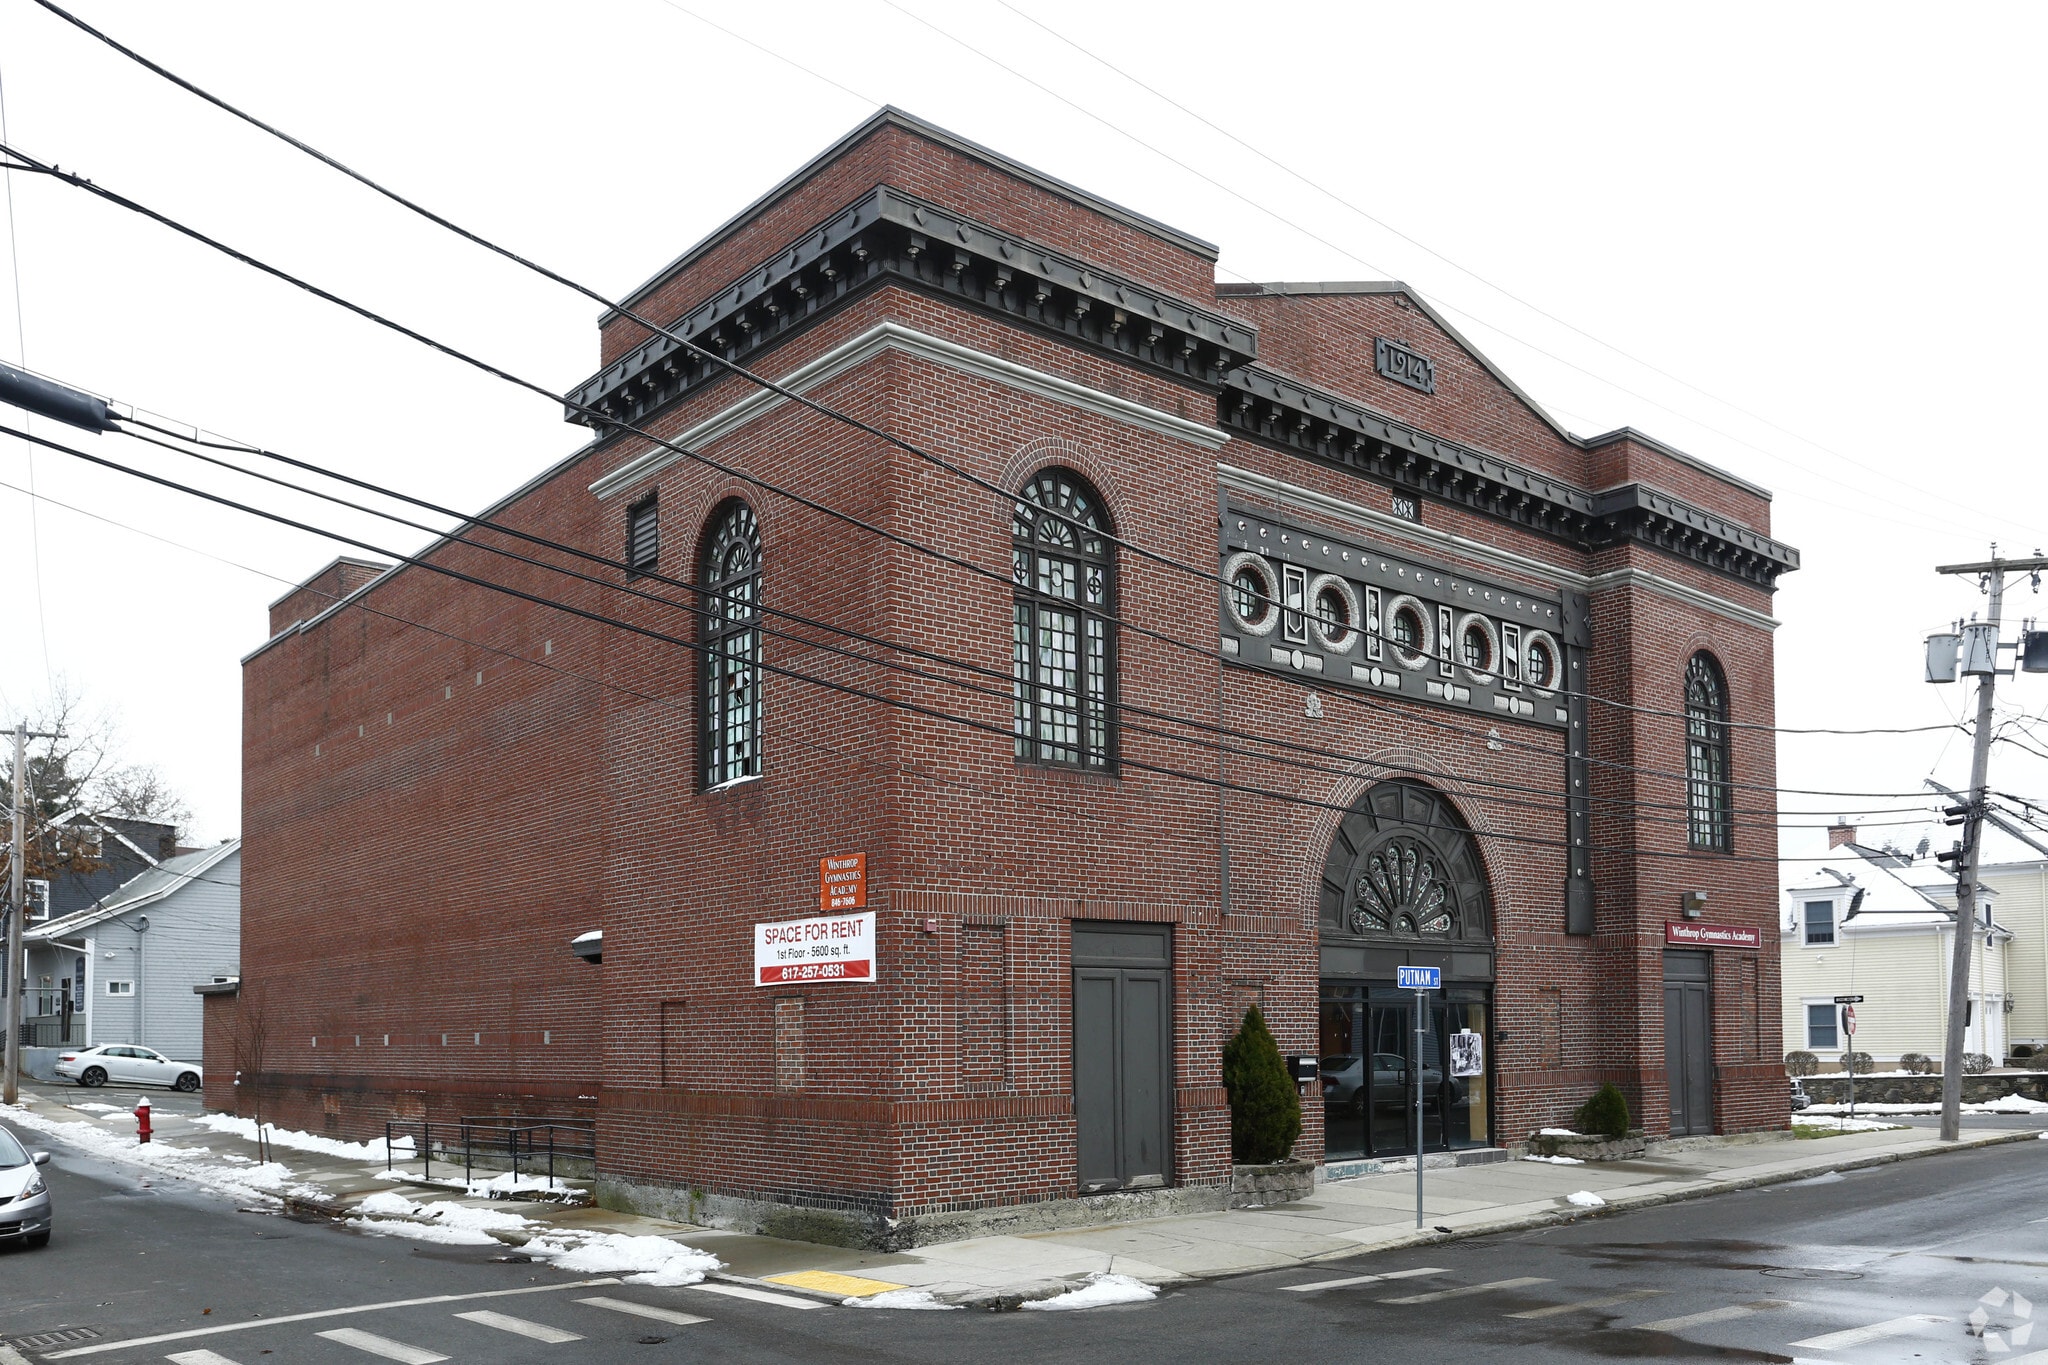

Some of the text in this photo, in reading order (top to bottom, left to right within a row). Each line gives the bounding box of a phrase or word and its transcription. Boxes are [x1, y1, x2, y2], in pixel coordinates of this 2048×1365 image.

[1389, 348, 1424, 383] 1914
[765, 919, 864, 945] SPACE FOR RENT
[1672, 925, 1755, 943] Winthrop Gymnastics Academy
[776, 950, 787, 960] 1st
[787, 948, 806, 959] Floor
[811, 945, 829, 957] 5600
[830, 949, 842, 958] sq.
[843, 943, 851, 955] ft.
[781, 964, 845, 979] 617-257-0531
[1400, 969, 1430, 985] PUTNAM
